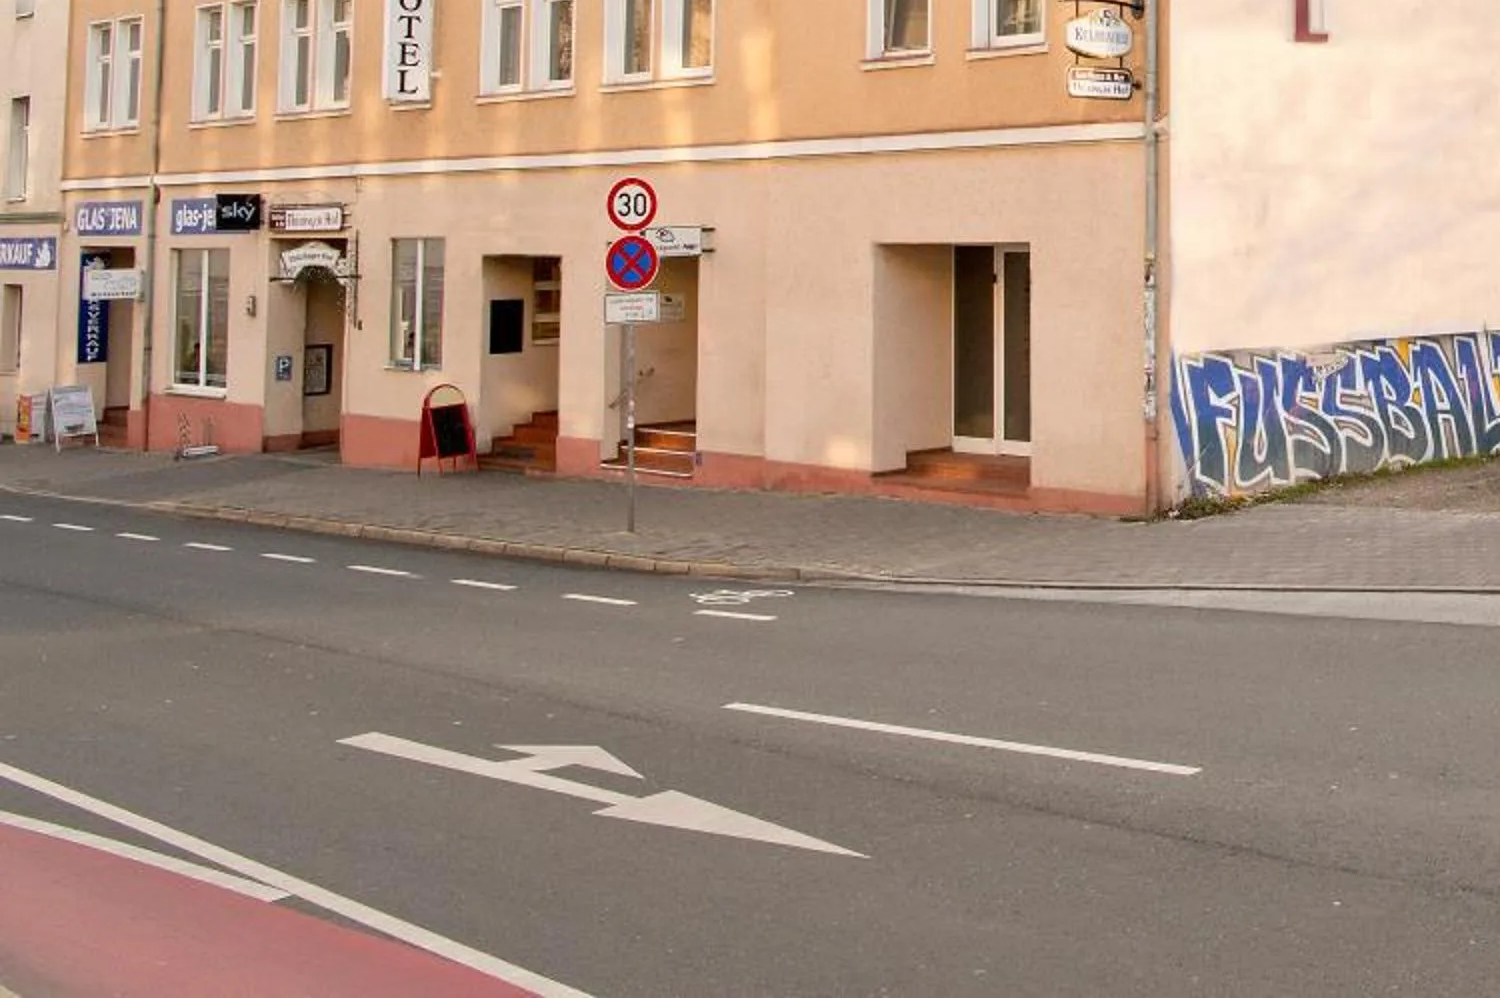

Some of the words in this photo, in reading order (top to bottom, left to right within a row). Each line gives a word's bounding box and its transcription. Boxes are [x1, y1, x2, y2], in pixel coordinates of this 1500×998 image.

[221, 201, 256, 221] sky
[617, 193, 647, 217] 30
[77, 207, 106, 231] GLAS
[109, 205, 138, 230] JENA
[175, 203, 217, 233] glas-je
